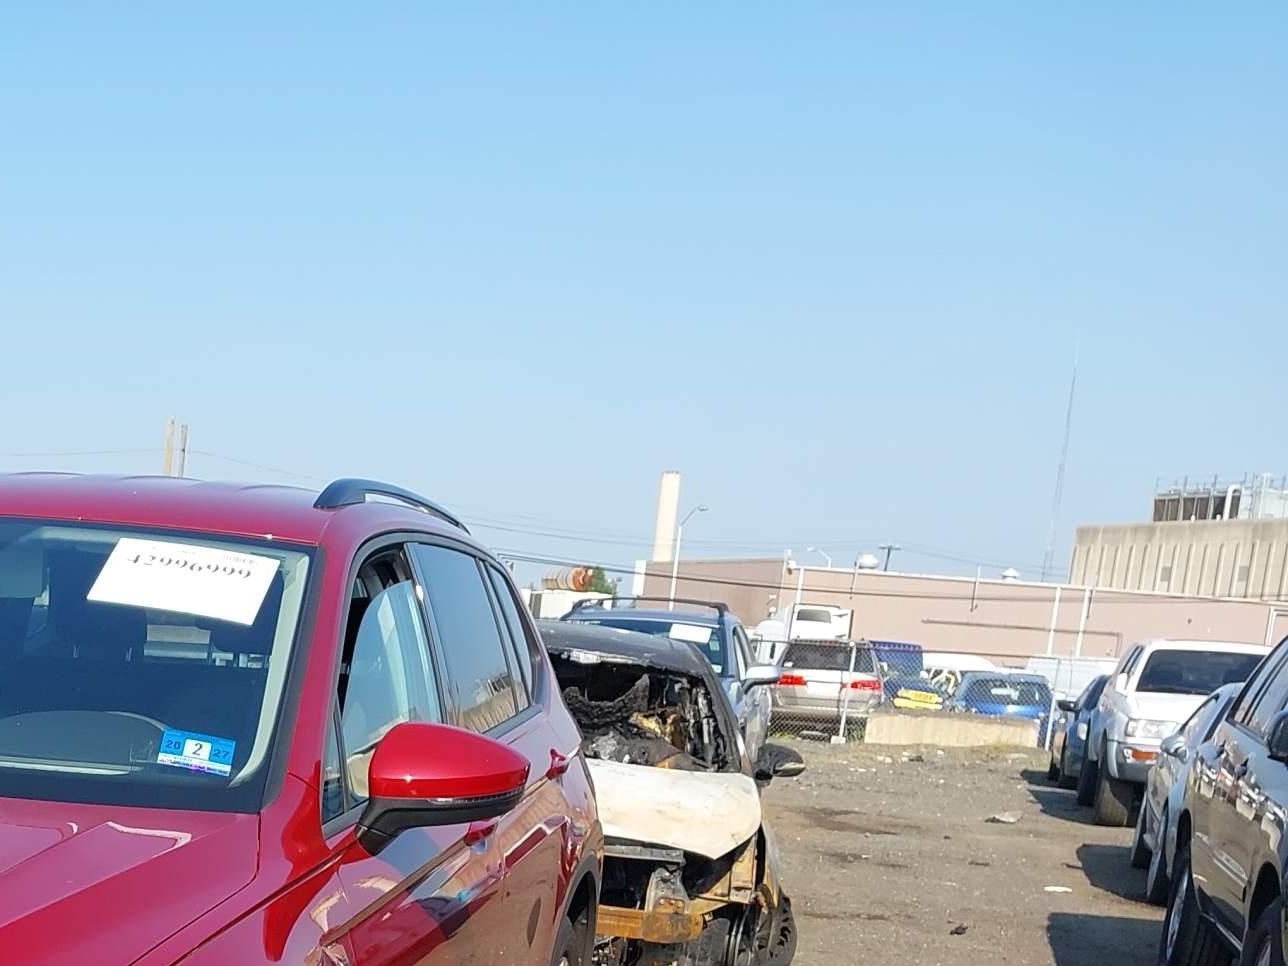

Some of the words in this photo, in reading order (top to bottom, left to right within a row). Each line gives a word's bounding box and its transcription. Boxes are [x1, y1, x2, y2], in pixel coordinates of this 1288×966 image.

[165, 739, 182, 750] 20
[192, 742, 204, 756] 2
[213, 748, 230, 759] 27
